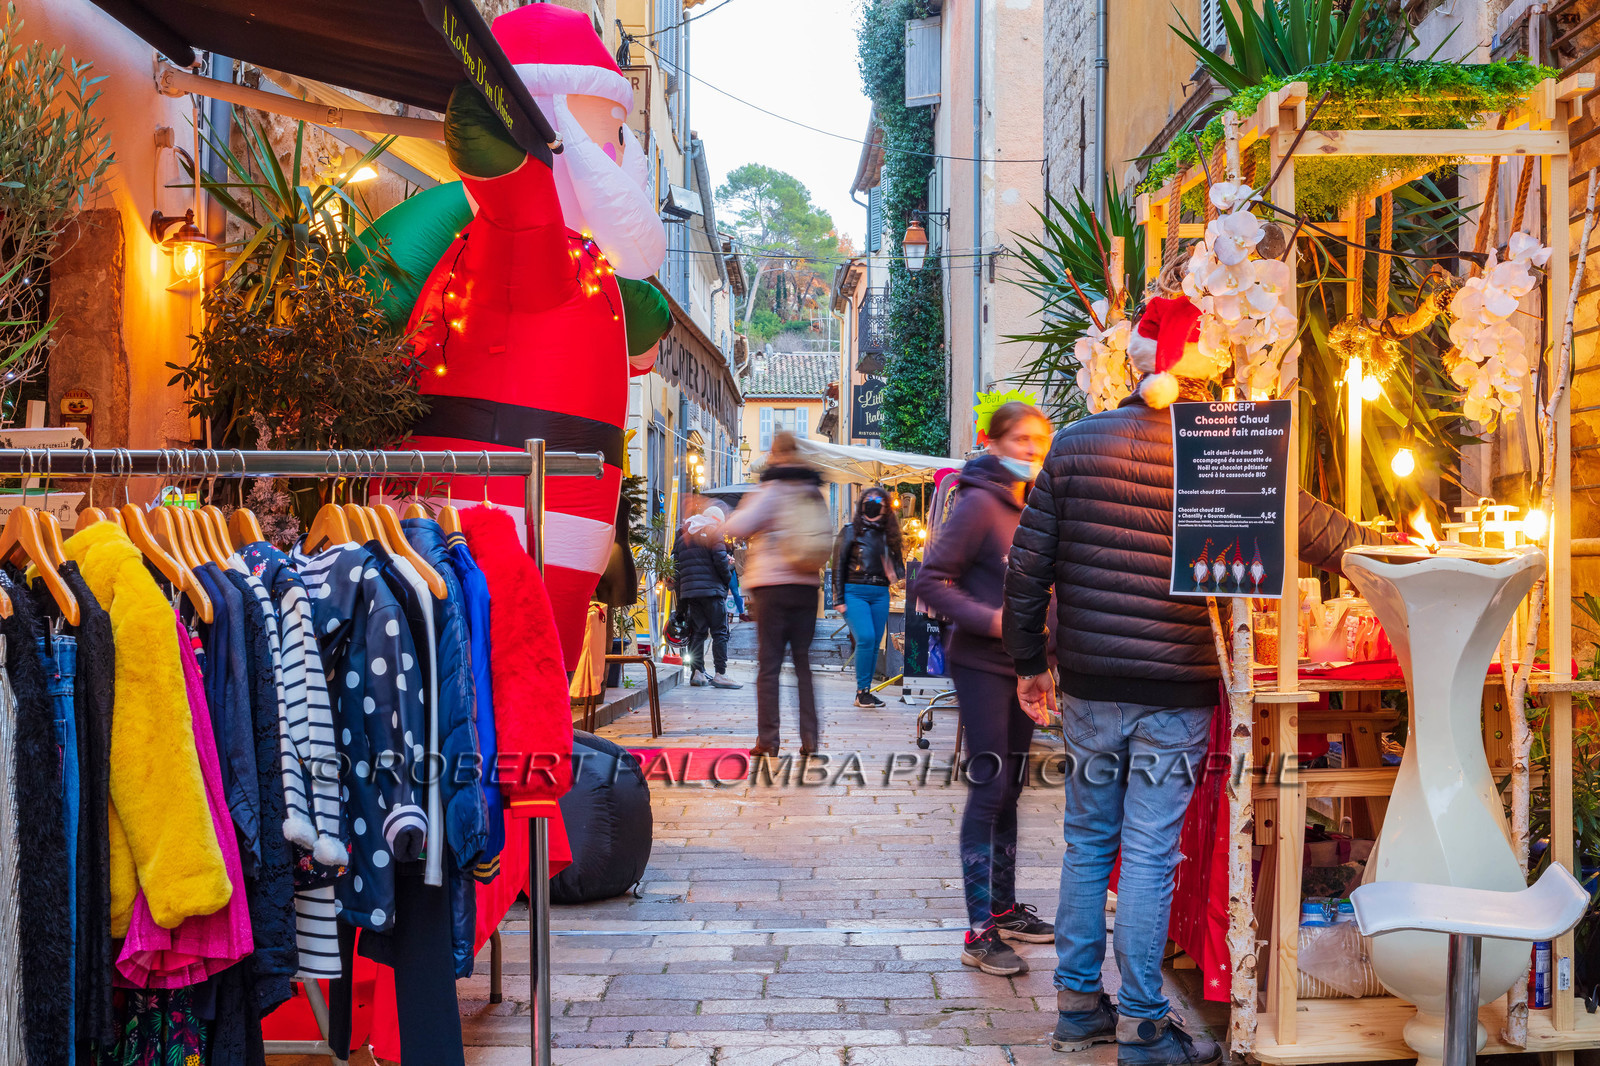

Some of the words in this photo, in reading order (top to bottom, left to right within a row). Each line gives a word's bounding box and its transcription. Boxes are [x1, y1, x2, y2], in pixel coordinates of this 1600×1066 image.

[857, 390, 885, 408] Littl
[1209, 402, 1257, 412] CONCEPT
[1194, 415, 1238, 425] Chocolat
[1239, 414, 1270, 424] Chaud
[1179, 428, 1230, 437] Gourmand
[1231, 427, 1249, 437] fait
[1250, 427, 1284, 437] maison
[1192, 457, 1227, 465] accompagné
[1243, 464, 1268, 472] pâtissier
[1261, 487, 1277, 496] 3,5€
[1260, 511, 1277, 520] 4,5€
